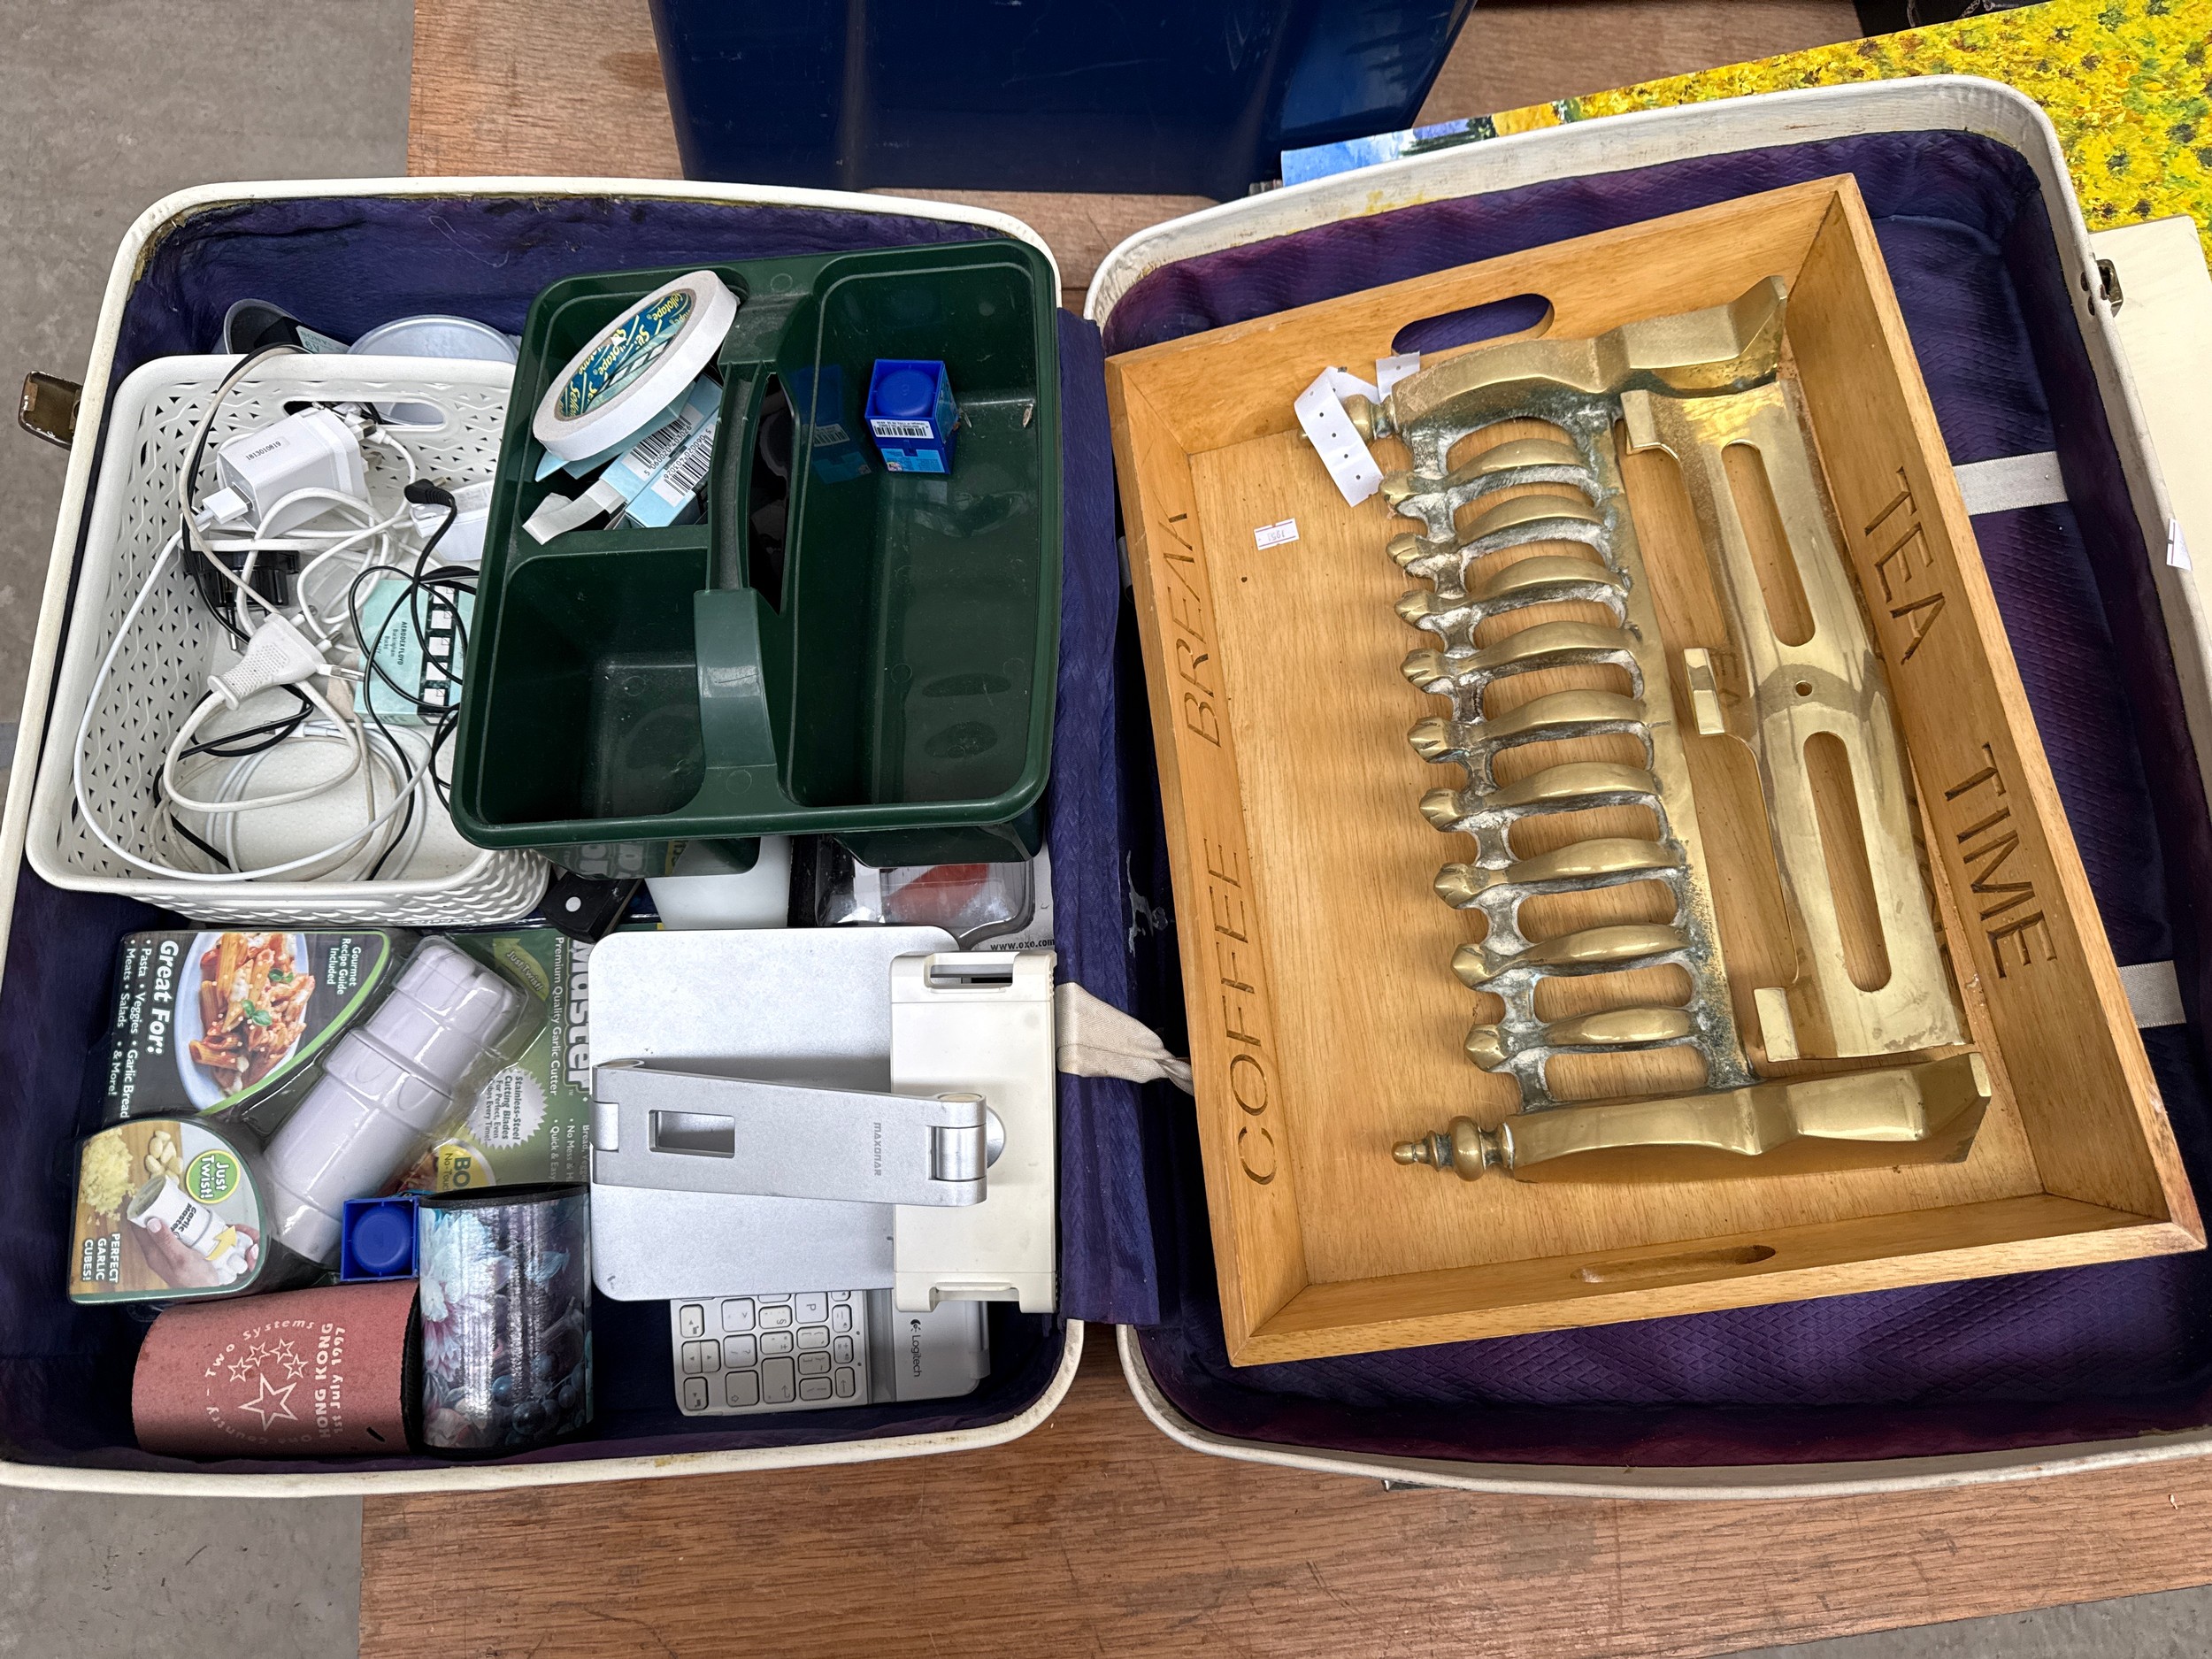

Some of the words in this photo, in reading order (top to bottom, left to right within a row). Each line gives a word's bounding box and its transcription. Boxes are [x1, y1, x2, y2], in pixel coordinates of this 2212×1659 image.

[1153, 489, 1221, 749] BREAK
[1863, 465, 1946, 665] TEA
[1945, 741, 2057, 979] TIME
[338, 938, 351, 967] Recipe
[553, 936, 565, 984] Premium
[991, 939, 1055, 951] www.oxo.com
[123, 948, 136, 980] Meats
[138, 948, 151, 977] Pasta
[153, 940, 180, 1002] Great
[326, 948, 340, 985] Included
[349, 947, 362, 987] Gourmet
[506, 950, 523, 969] Just
[520, 965, 544, 992] Twist!
[337, 969, 349, 995] Guide
[117, 992, 130, 1028] Salads
[130, 992, 146, 1034] Veggies
[551, 986, 564, 1025] Quality
[1203, 837, 1278, 1186] COFFEE
[147, 1008, 171, 1055] For:
[550, 1027, 562, 1057] Garlic
[112, 1050, 122, 1060] &
[124, 1049, 138, 1083] Garlic
[108, 1062, 120, 1096] More!
[501, 1075, 513, 1108] Cutting
[549, 1060, 561, 1096] Cutter
[120, 1085, 134, 1118] Bread
[484, 1101, 494, 1119] Every
[493, 1093, 503, 1121] Perfect,
[512, 1076, 524, 1141] Stainless-Steel
[484, 1120, 493, 1142] Time!
[493, 1122, 502, 1139] Even
[502, 1110, 512, 1140] Blades
[549, 1125, 560, 1151] Quick
[566, 1125, 575, 1138] No
[566, 1139, 575, 1162] Mess
[200, 1156, 215, 1199] Twist!
[215, 1162, 229, 1191] Just
[452, 1156, 472, 1188] BO
[549, 1161, 559, 1180] Easy
[171, 1202, 192, 1233] Master
[178, 1207, 196, 1232] Garlic
[82, 1239, 94, 1281] CUBES!
[96, 1238, 107, 1281] GARLIC
[109, 1233, 121, 1283] PERFECT
[204, 1343, 235, 1378] Two
[315, 1323, 334, 1381] KONG
[332, 1327, 346, 1366] 1997
[910, 1334, 923, 1378] Logitech
[330, 1374, 344, 1409] July
[314, 1388, 331, 1439] HONG
[333, 1415, 343, 1434] 1st
